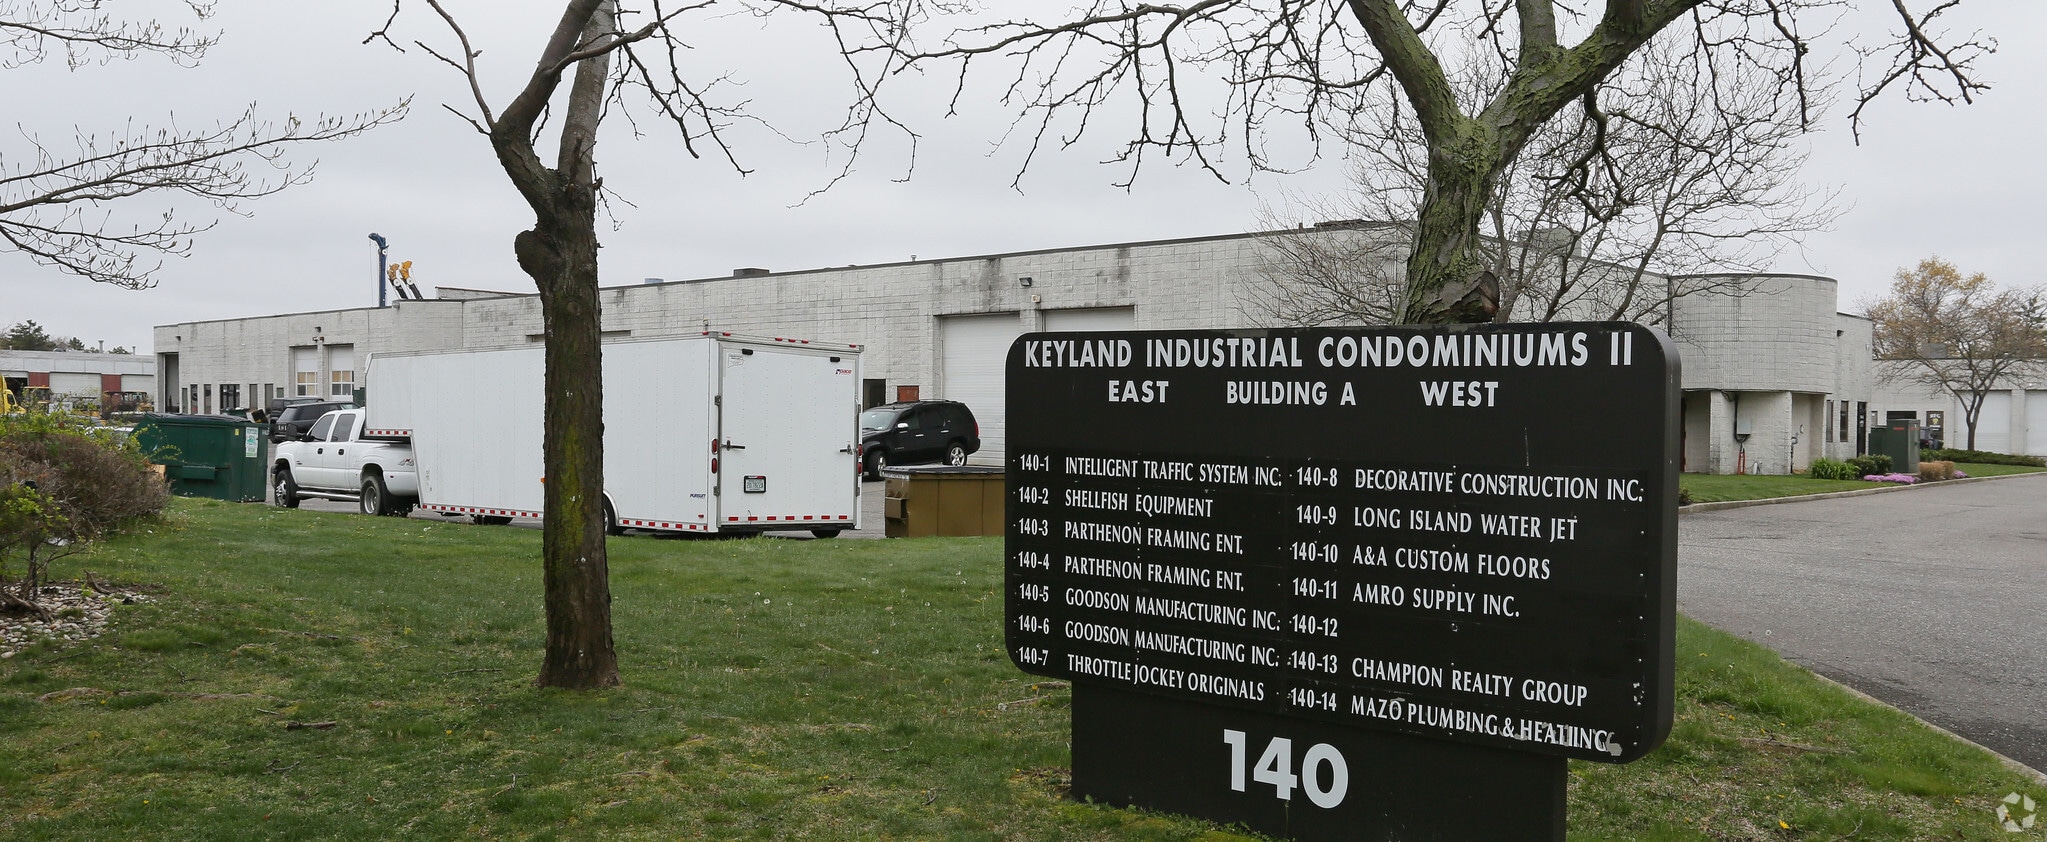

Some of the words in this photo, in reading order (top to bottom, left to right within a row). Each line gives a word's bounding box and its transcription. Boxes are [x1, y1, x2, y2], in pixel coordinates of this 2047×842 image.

[1026, 340, 1131, 367] KEYLAND
[1147, 338, 1302, 367] INDUSTRIAL
[1318, 332, 1588, 367] CONDOMINIUMS
[1611, 332, 1631, 365] II
[1109, 380, 1168, 402] EAST
[1227, 382, 1327, 405] BUILDING
[1340, 382, 1356, 405] A
[1420, 381, 1498, 407] WEST
[1020, 454, 1048, 471] 140-1
[1066, 457, 1138, 477] INTELLIGENT
[1143, 461, 1193, 481] TRAFFIC
[1200, 464, 1248, 484] SYSTEM
[1256, 467, 1281, 486] INC.
[1297, 467, 1337, 486] 140-8
[1355, 469, 1453, 492] DECORATIVE
[1461, 473, 1597, 499] CONSTRUCTION
[1608, 479, 1643, 502] INC.
[1019, 487, 1048, 504] 140-2
[1066, 489, 1127, 510] SHELLFISH
[1136, 494, 1213, 517] EQUIPMENT
[1019, 518, 1048, 536] 140-3
[1066, 521, 1141, 544] PARTHENON
[1148, 528, 1210, 550] FRAMING
[1217, 534, 1242, 554] ENT.
[1297, 505, 1336, 525] 140-9
[1355, 507, 1400, 528] LONG
[1410, 510, 1471, 532] ISLAND
[1481, 514, 1541, 538] WATER
[1550, 516, 1577, 542] JET
[1018, 552, 1049, 569] 140-4
[1065, 556, 1141, 580] PARTHENON
[1148, 564, 1210, 587] FRAMING
[1217, 571, 1244, 591] ENT.
[1292, 542, 1338, 563] 140-10
[1353, 545, 1387, 566] A&A
[1396, 548, 1468, 573] CUSTOM
[1478, 554, 1550, 579] FLOORS
[1020, 584, 1048, 602] 140-5
[1066, 588, 1128, 611] GOODSON
[1136, 596, 1245, 626] MANUFACTURING
[1253, 610, 1280, 631] INC.
[1293, 578, 1336, 599] 140-11
[1353, 583, 1404, 606] AMRO
[1413, 588, 1475, 612] SUPPLY
[1484, 594, 1519, 617] INC.
[1019, 615, 1049, 634] 140-6
[1066, 621, 1128, 645] GOODSON
[1135, 630, 1244, 662] MANUFACTURING
[1252, 646, 1279, 666] INC.
[1293, 614, 1337, 637] 140-12
[1019, 647, 1048, 665] 140-7
[1068, 654, 1130, 680] THROTTLE
[1134, 664, 1184, 688] JOCKEY
[1188, 673, 1264, 700] ORIGINALS
[1292, 651, 1337, 673] 140-13
[1352, 658, 1442, 687] CHAMPION
[1452, 670, 1513, 696] REALTY
[1522, 680, 1587, 706] GROUP
[1291, 688, 1336, 711] 140-14
[1351, 695, 1402, 720] MAZO
[1408, 703, 1497, 735] PLUMBING
[1503, 718, 1514, 737] &
[1224, 729, 1348, 808] 140
